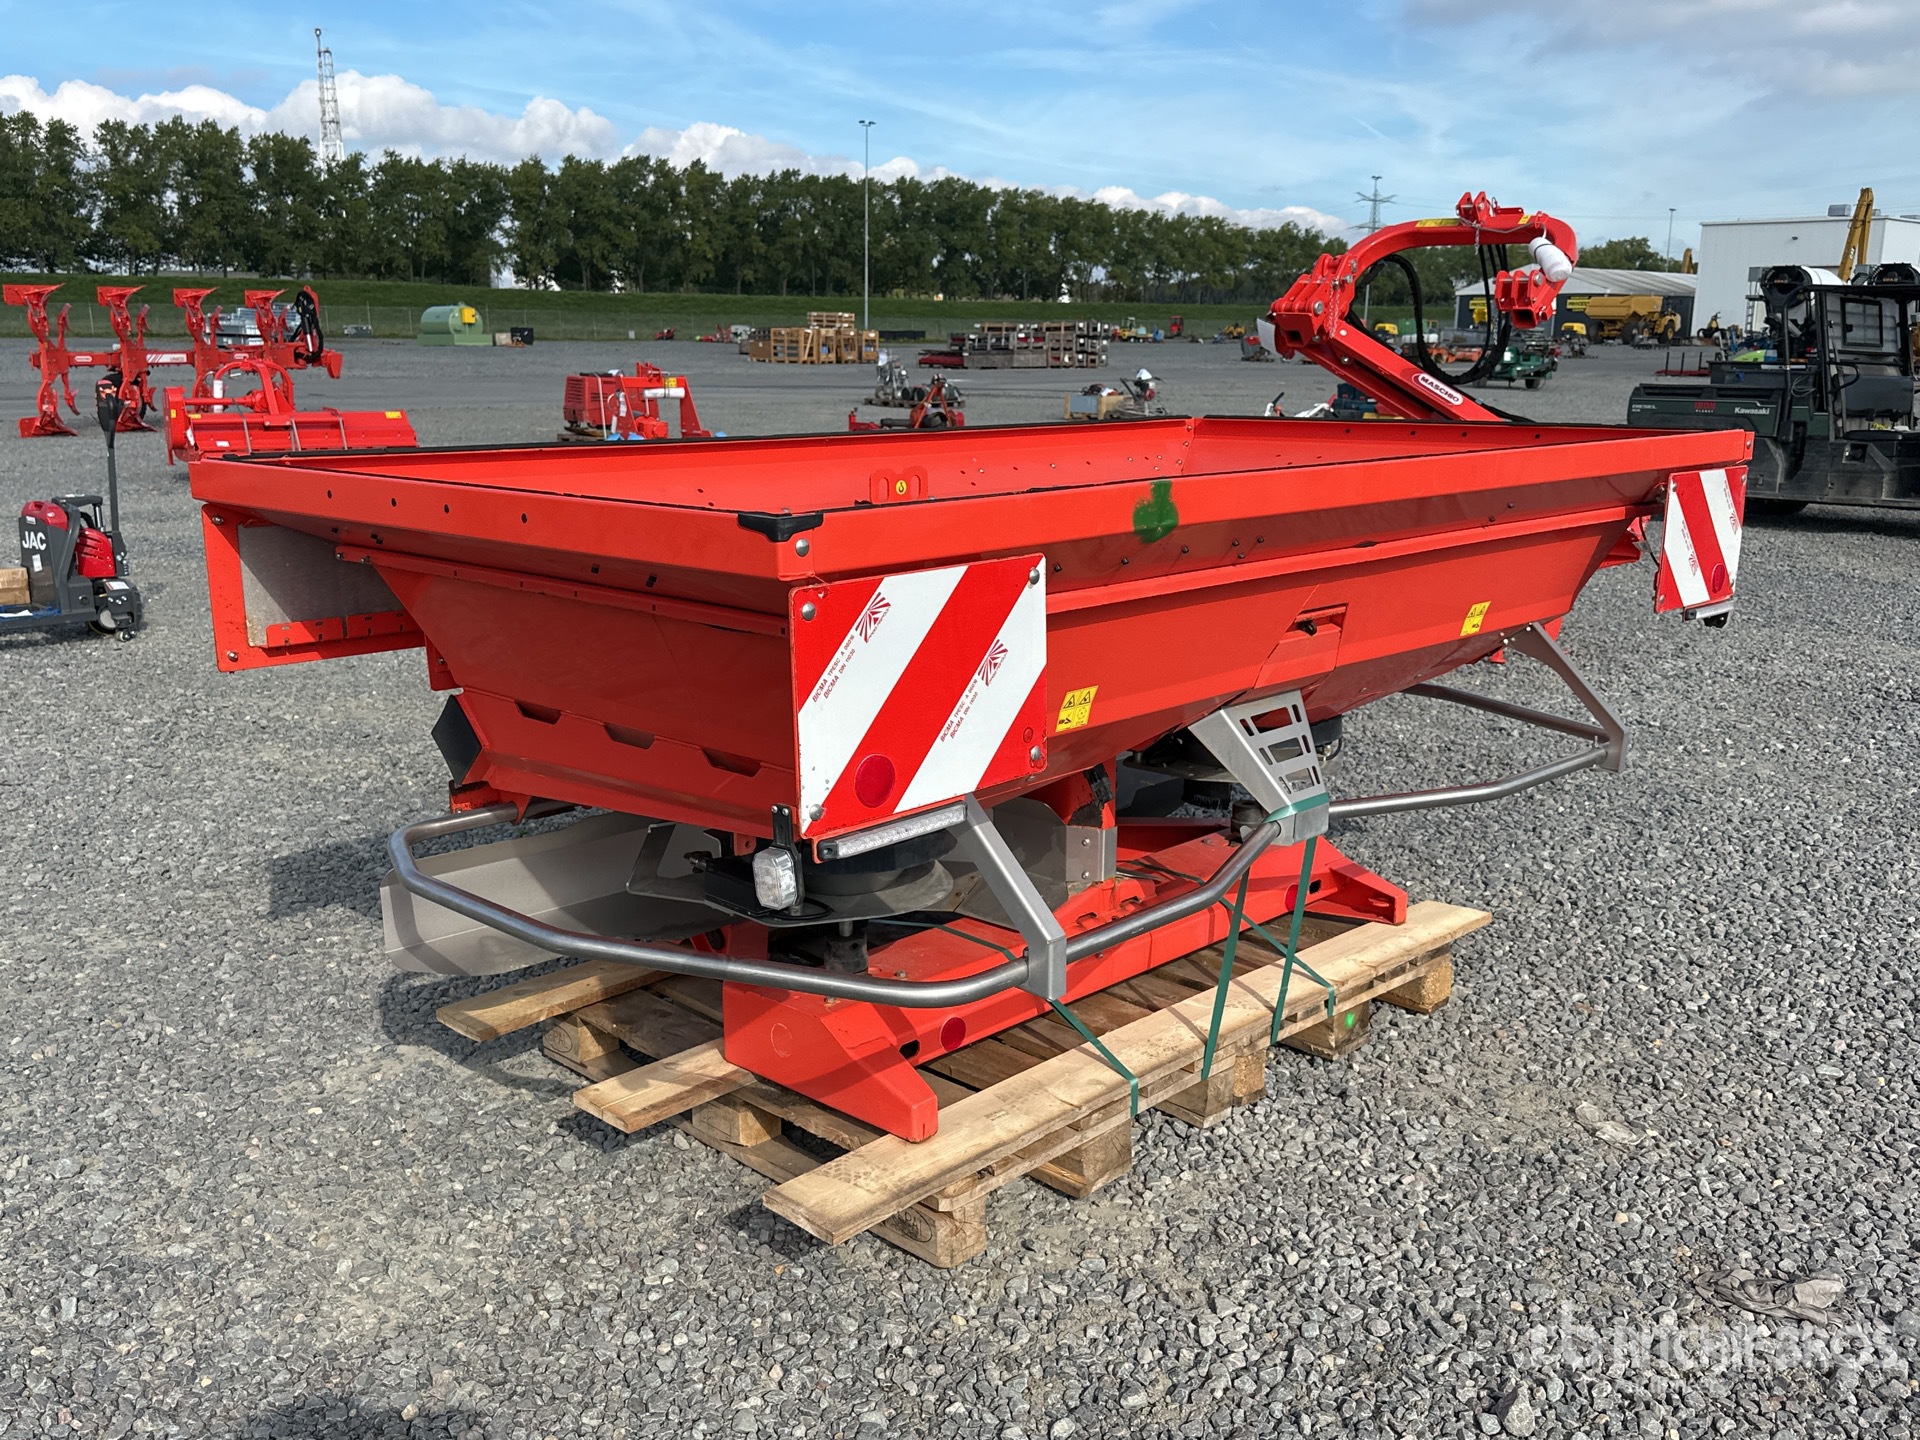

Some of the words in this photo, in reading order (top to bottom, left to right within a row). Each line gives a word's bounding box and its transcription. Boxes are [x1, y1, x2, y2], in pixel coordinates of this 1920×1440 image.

[1420, 375, 1460, 403] MASCHIO
[1734, 407, 1770, 415] Kawasaki
[22, 531, 47, 551] JAC
[812, 678, 829, 702] BICMA
[823, 675, 840, 700] BICMA
[940, 720, 955, 742] BICMA
[949, 716, 965, 739] BICMA
